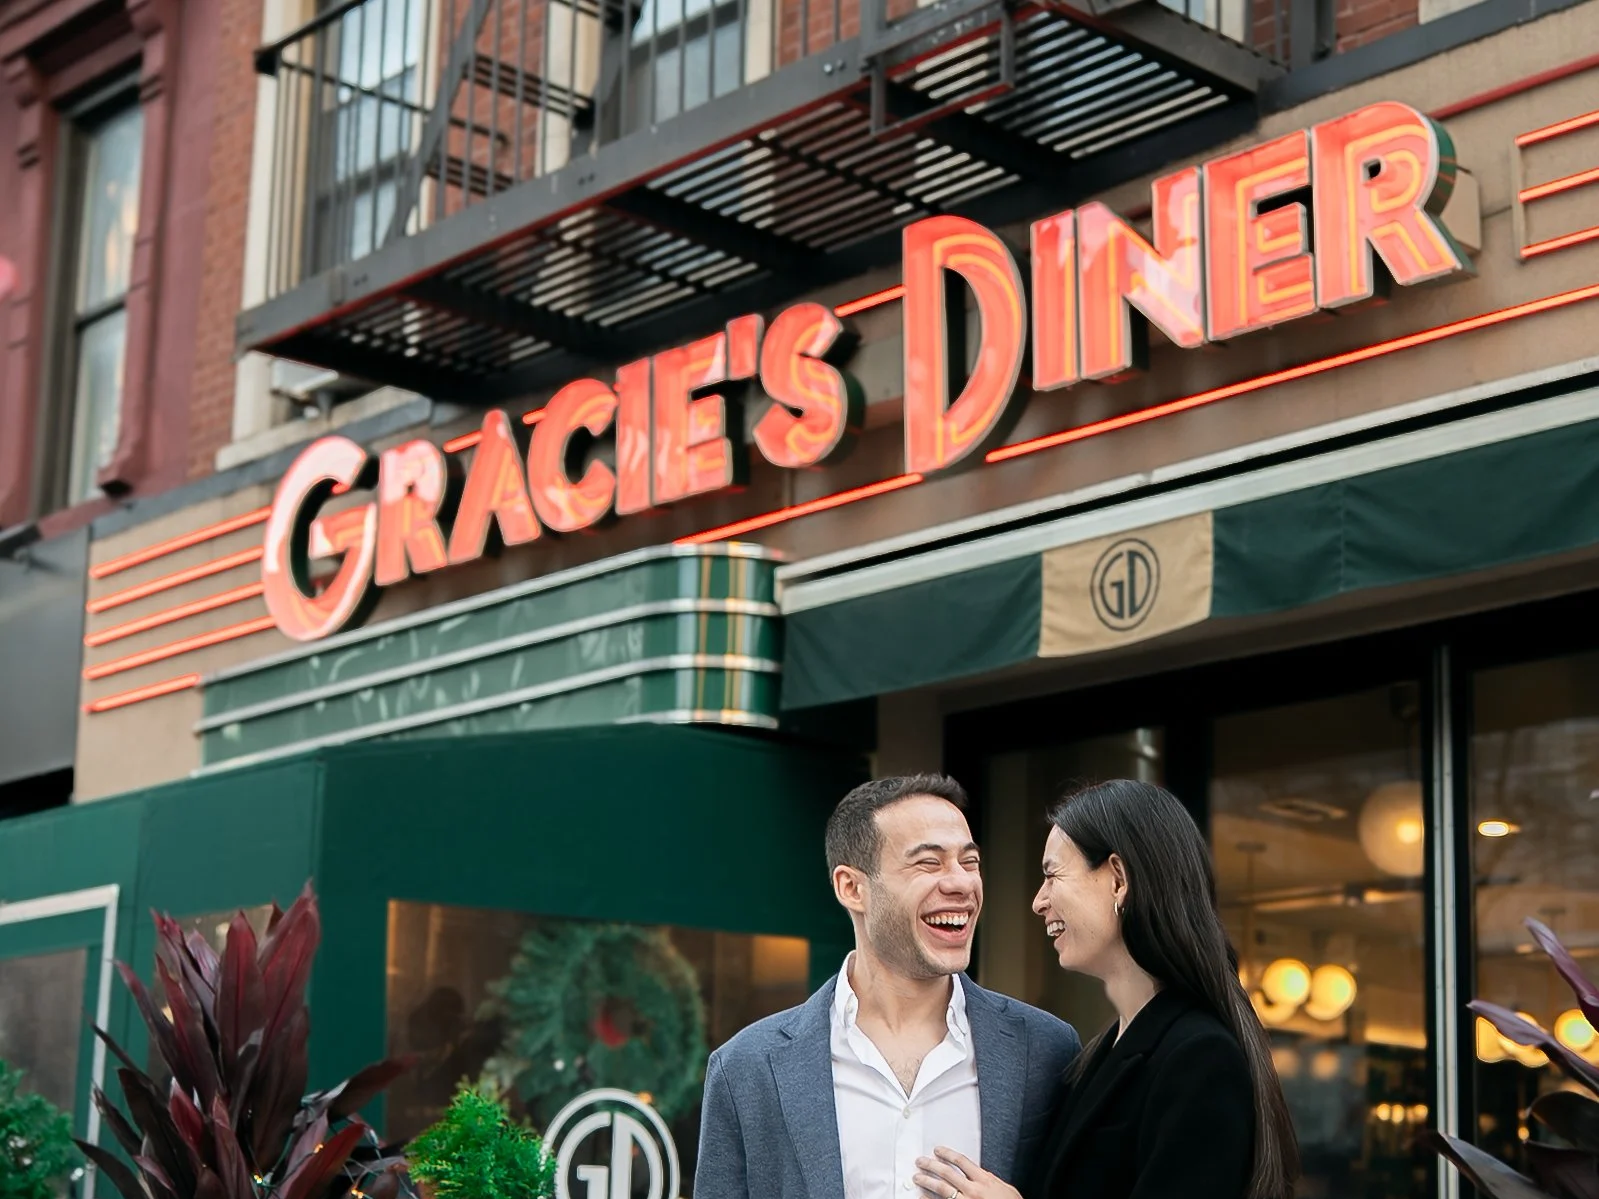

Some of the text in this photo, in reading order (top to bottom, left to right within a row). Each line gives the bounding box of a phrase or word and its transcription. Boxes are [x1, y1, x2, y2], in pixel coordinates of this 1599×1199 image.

[262, 100, 1464, 642] GRACIE'S DINER
[1099, 549, 1152, 620] GD
